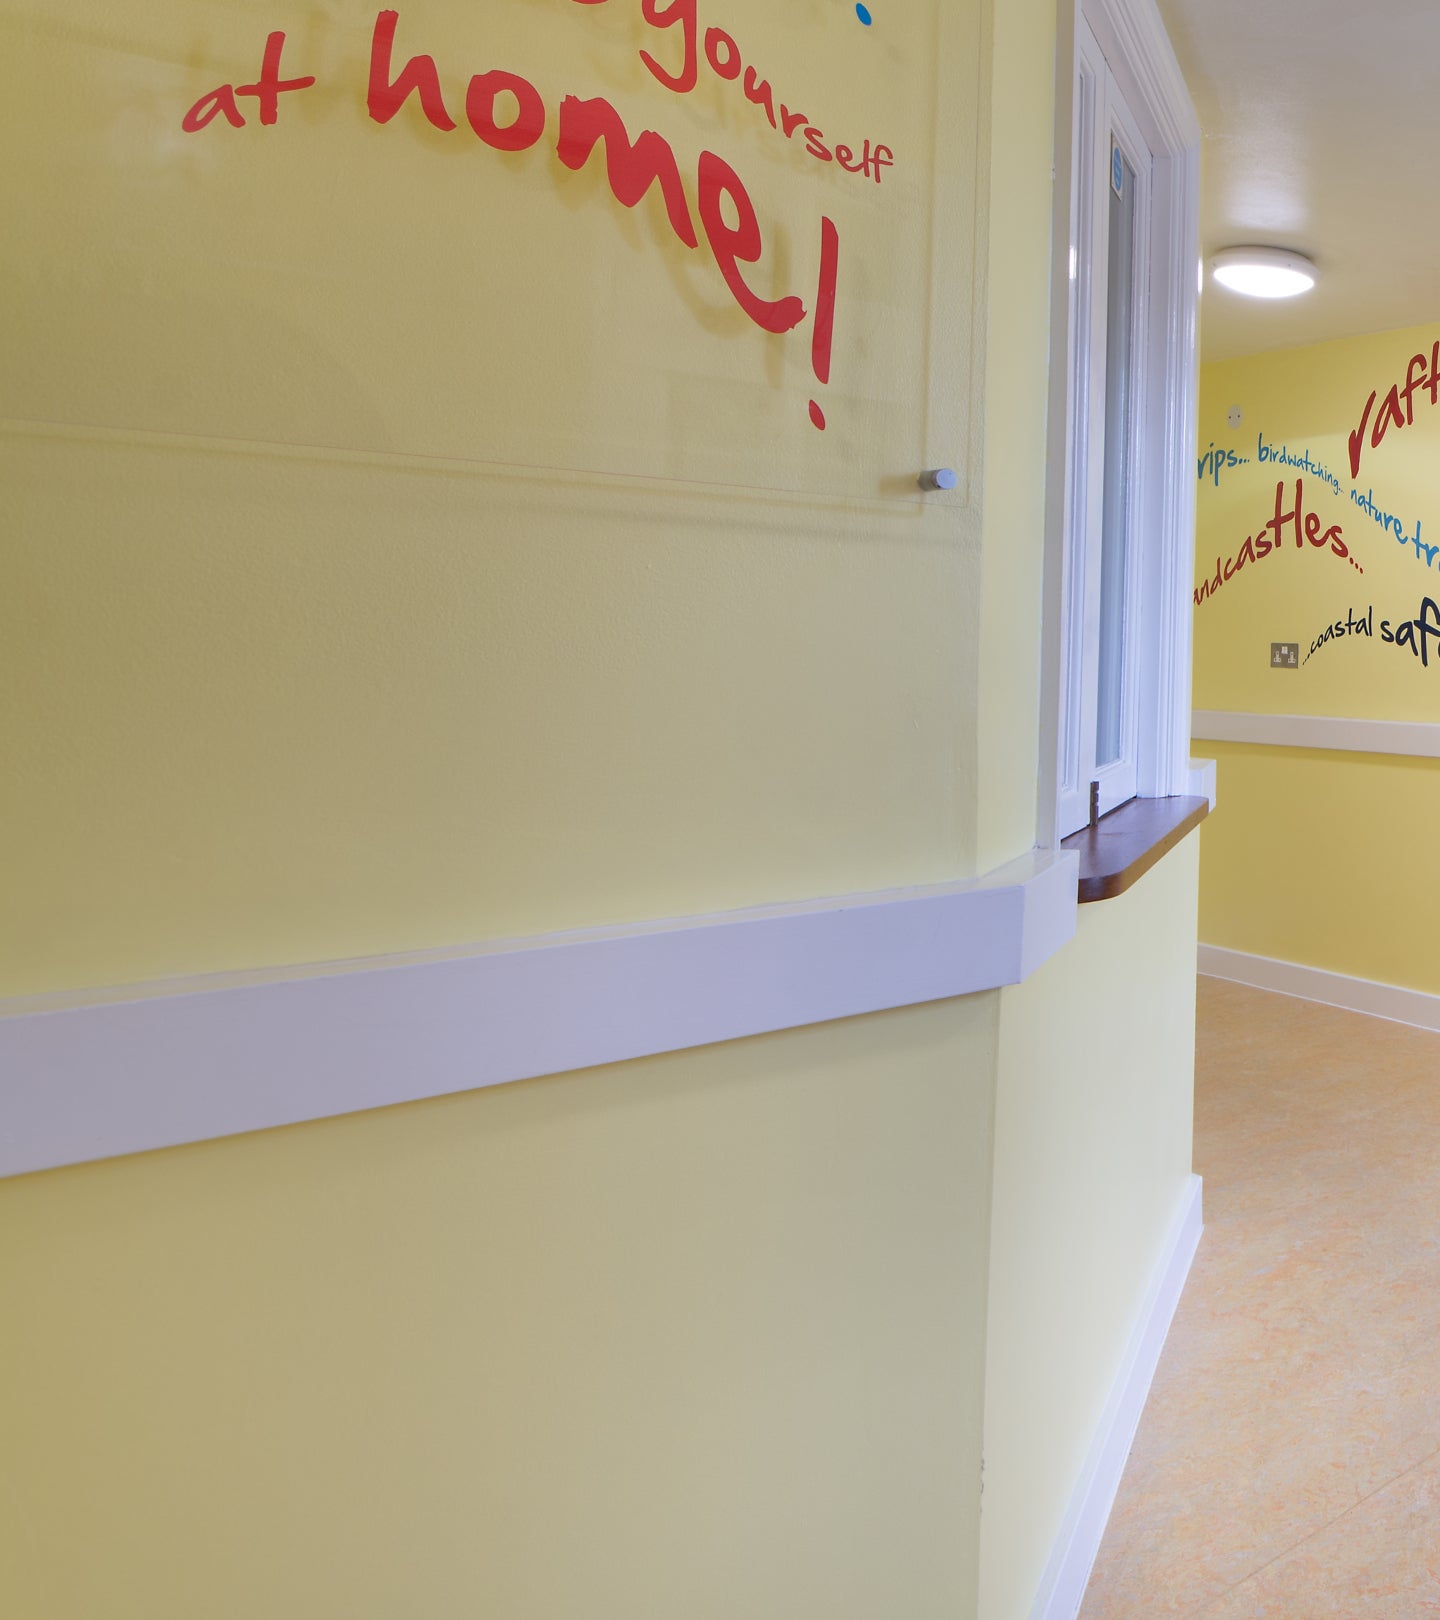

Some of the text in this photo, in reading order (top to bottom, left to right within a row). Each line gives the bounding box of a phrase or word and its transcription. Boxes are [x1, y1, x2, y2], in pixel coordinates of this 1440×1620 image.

[639, 0, 893, 183] yourself
[182, 10, 838, 430] at home!
[1351, 489, 1408, 544] nature
